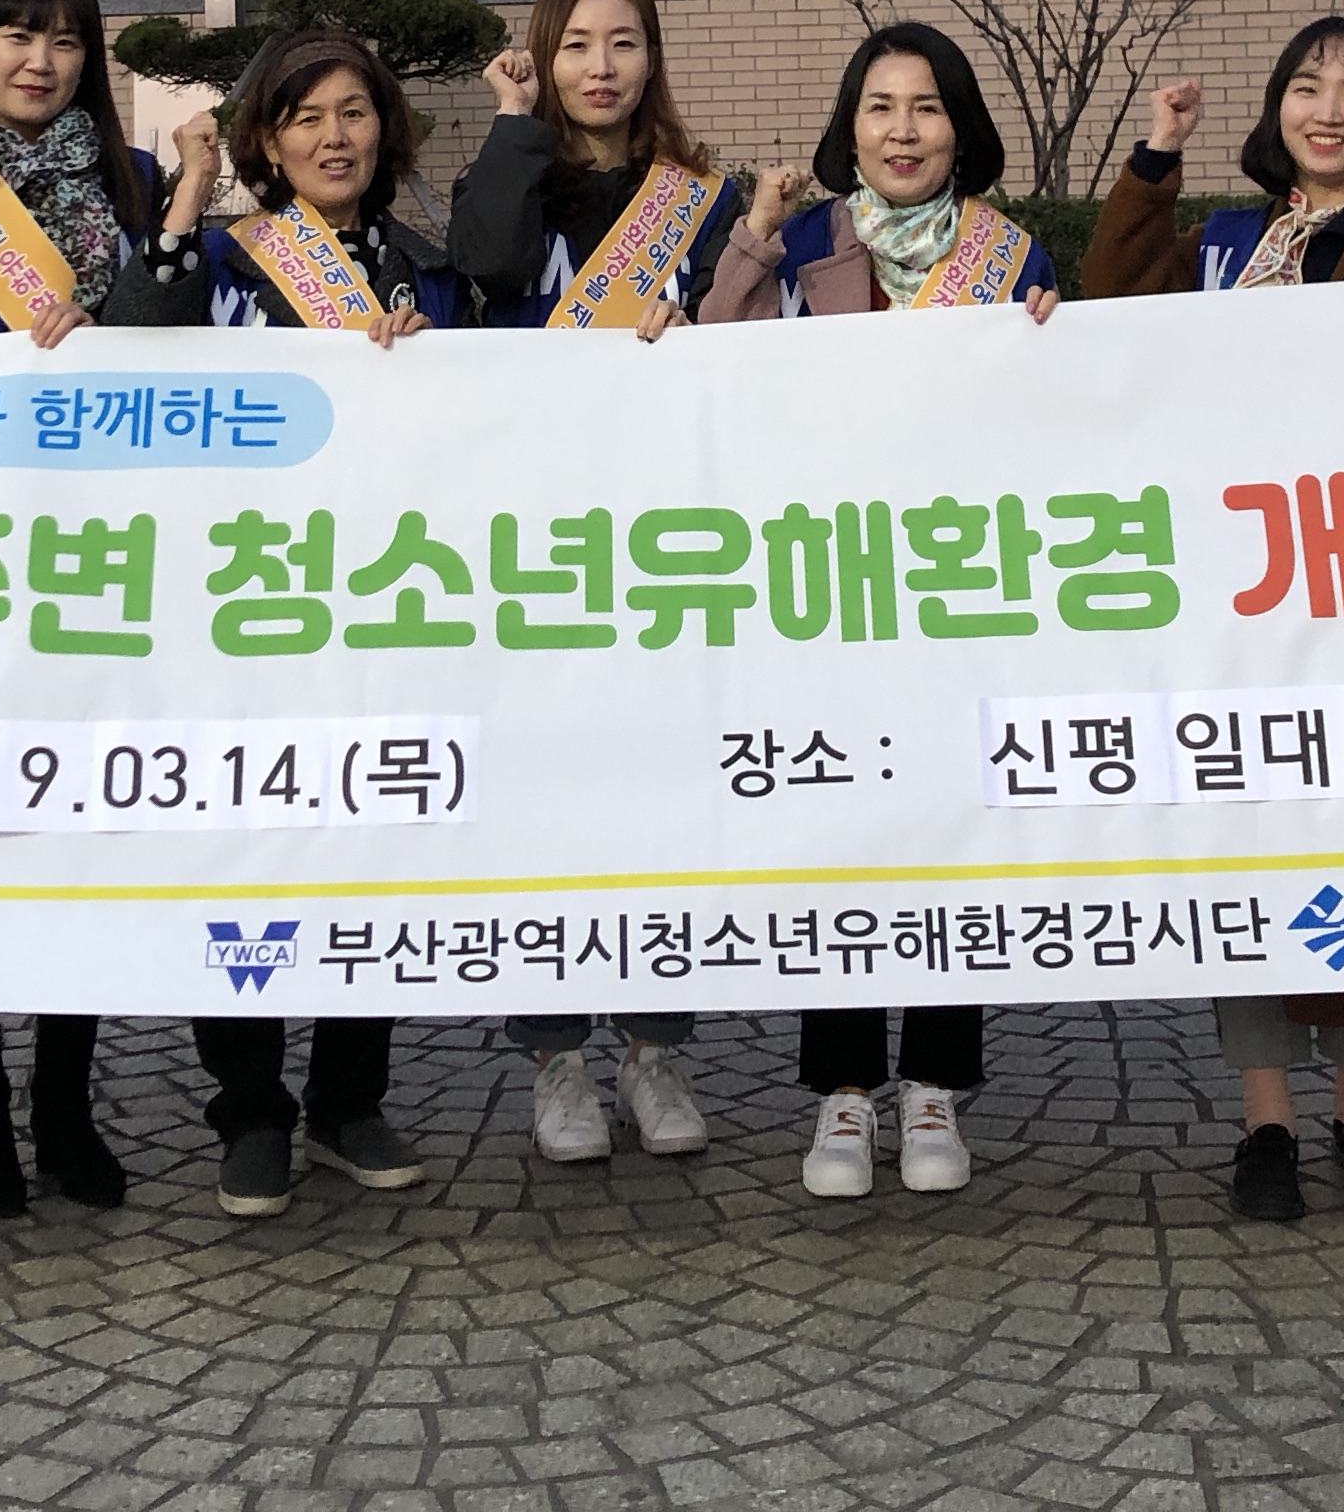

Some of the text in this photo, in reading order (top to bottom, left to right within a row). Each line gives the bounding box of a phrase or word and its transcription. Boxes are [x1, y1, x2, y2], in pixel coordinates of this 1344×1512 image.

[30, 387, 286, 451] 함께하는
[205, 484, 1181, 657] 청소년유해환경
[719, 728, 855, 799] 장소
[989, 716, 1137, 796] 신평
[1175, 709, 1331, 791] 일대
[214, 944, 290, 963] YWCA
[318, 896, 1272, 985] 부산광역시청소년유해환경감시단
